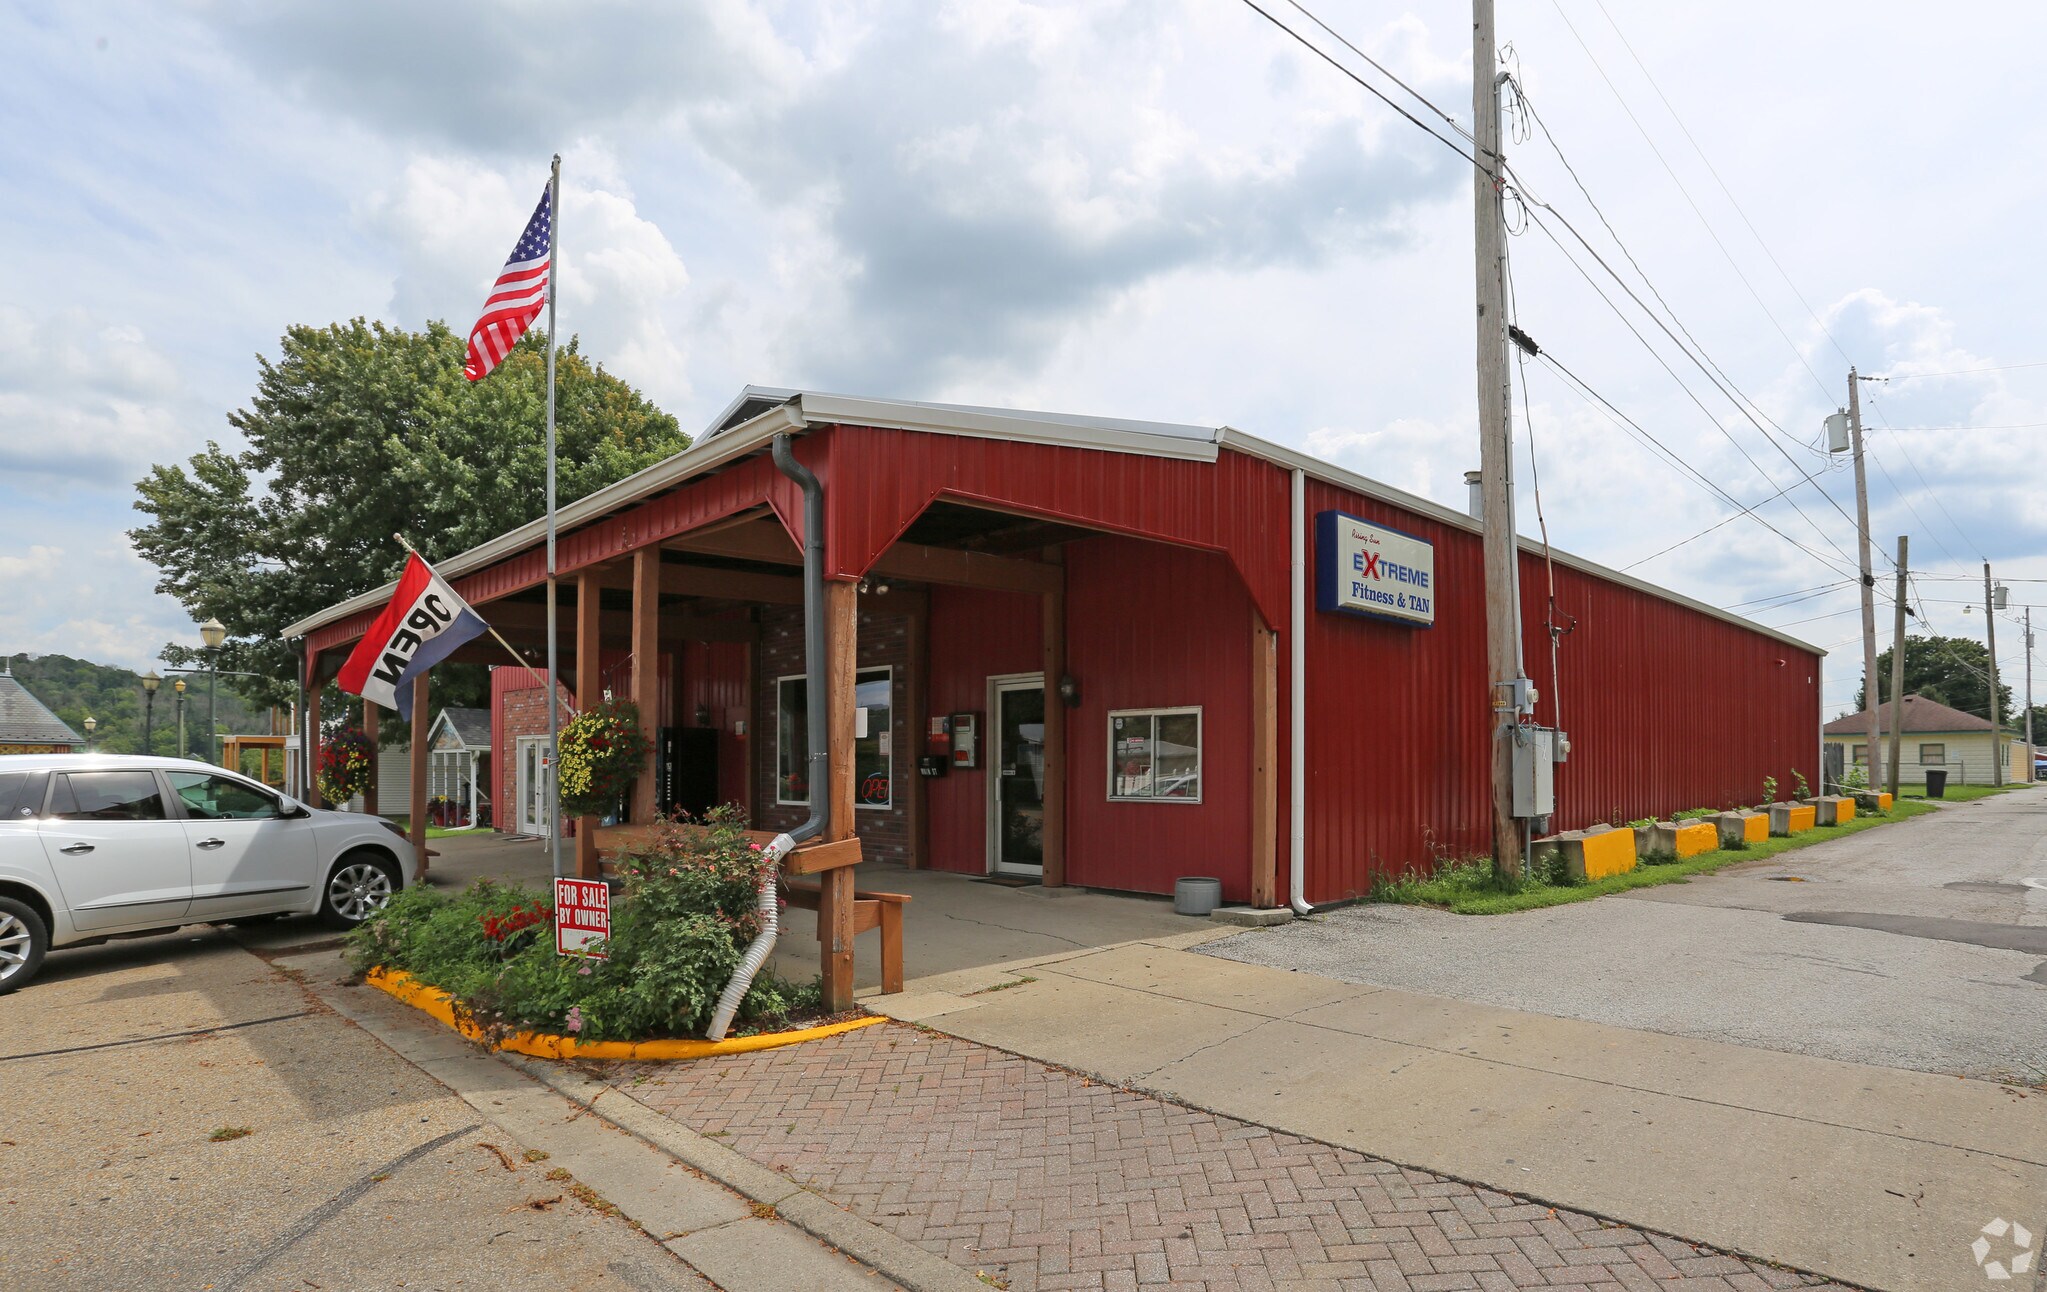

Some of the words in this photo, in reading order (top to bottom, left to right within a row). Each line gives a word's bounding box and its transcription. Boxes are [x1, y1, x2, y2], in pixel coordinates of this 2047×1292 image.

[1353, 549, 1429, 589] EXTREME
[1351, 581, 1395, 606] Fitness
[1397, 592, 1407, 608] &
[1408, 594, 1430, 613] TAN
[558, 884, 578, 906] FOR
[582, 886, 607, 909] SALE
[559, 907, 571, 924] BY
[574, 908, 607, 929] OWNER
